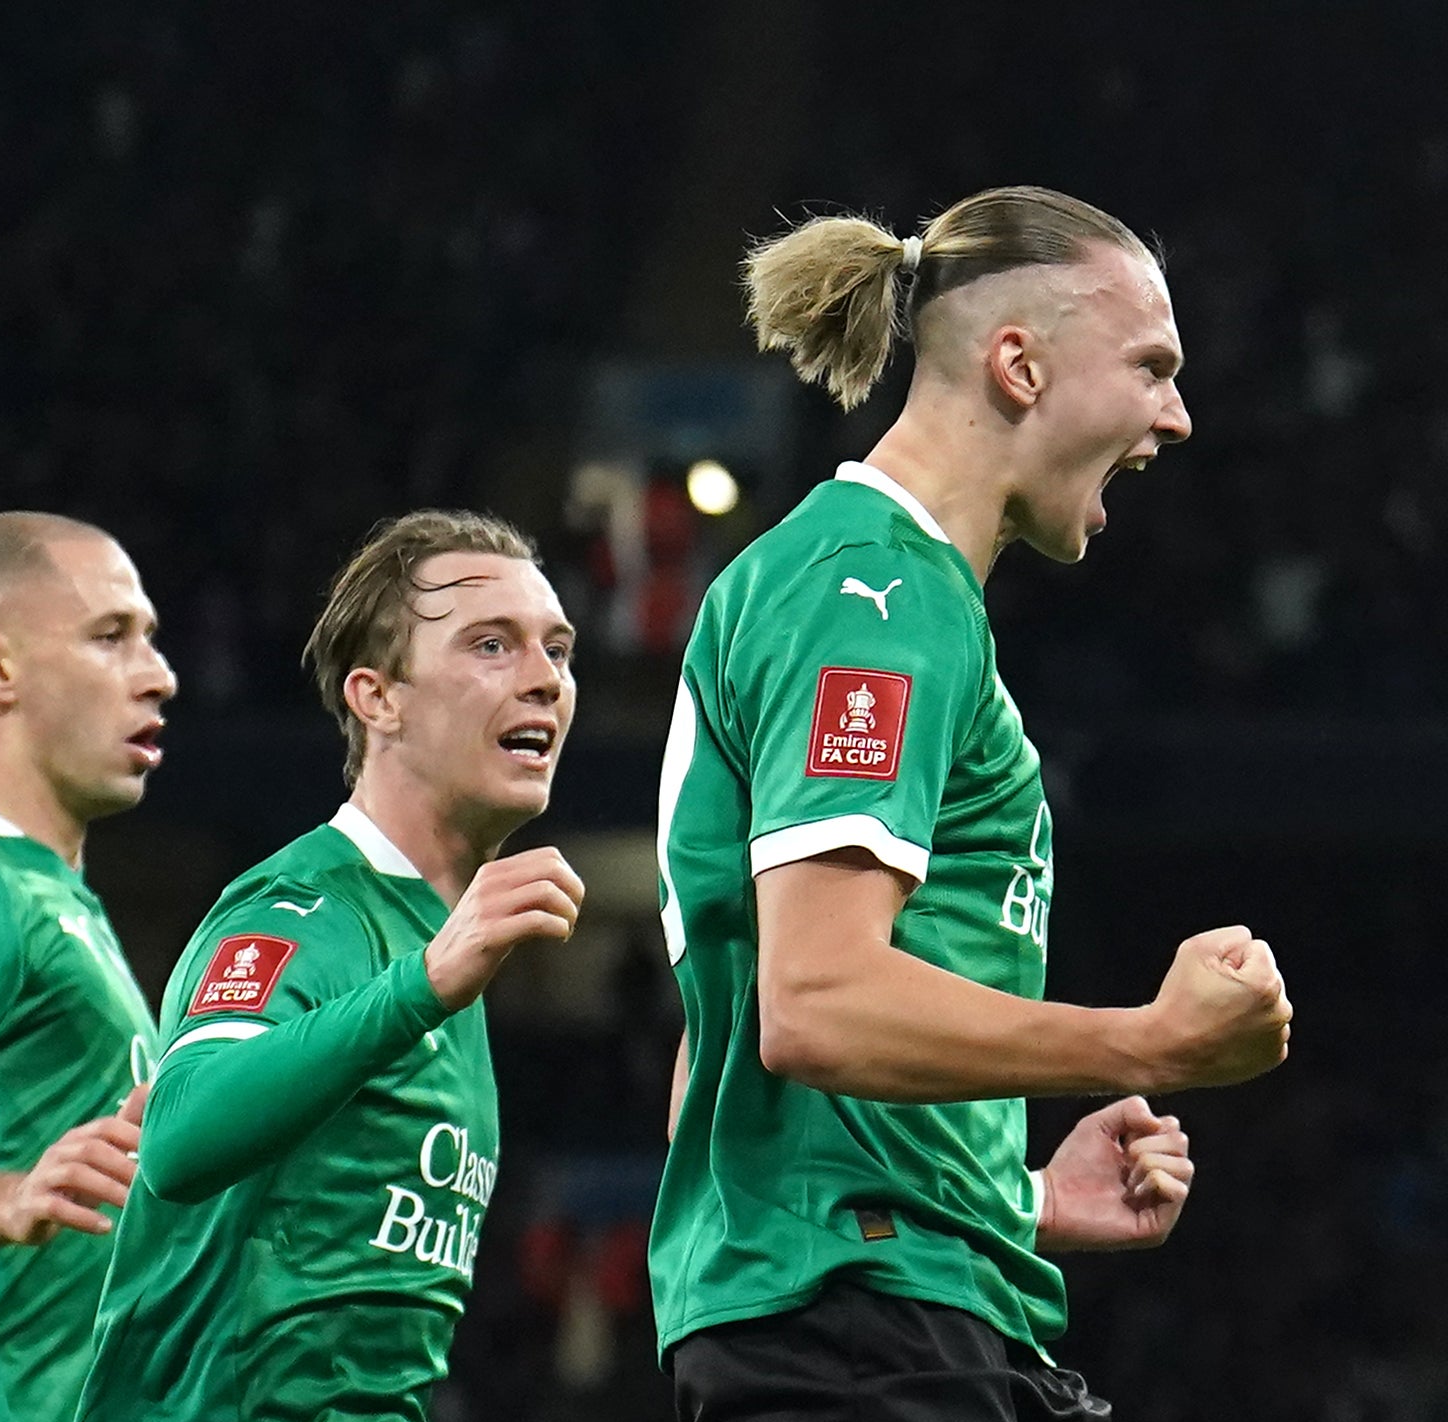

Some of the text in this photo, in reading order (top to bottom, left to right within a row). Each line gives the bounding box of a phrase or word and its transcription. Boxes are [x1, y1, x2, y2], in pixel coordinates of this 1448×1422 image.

[822, 733, 887, 750] Emirates
[820, 748, 886, 765] FA CUP
[201, 990, 258, 1004] FA CUP
[419, 1122, 498, 1208] Class
